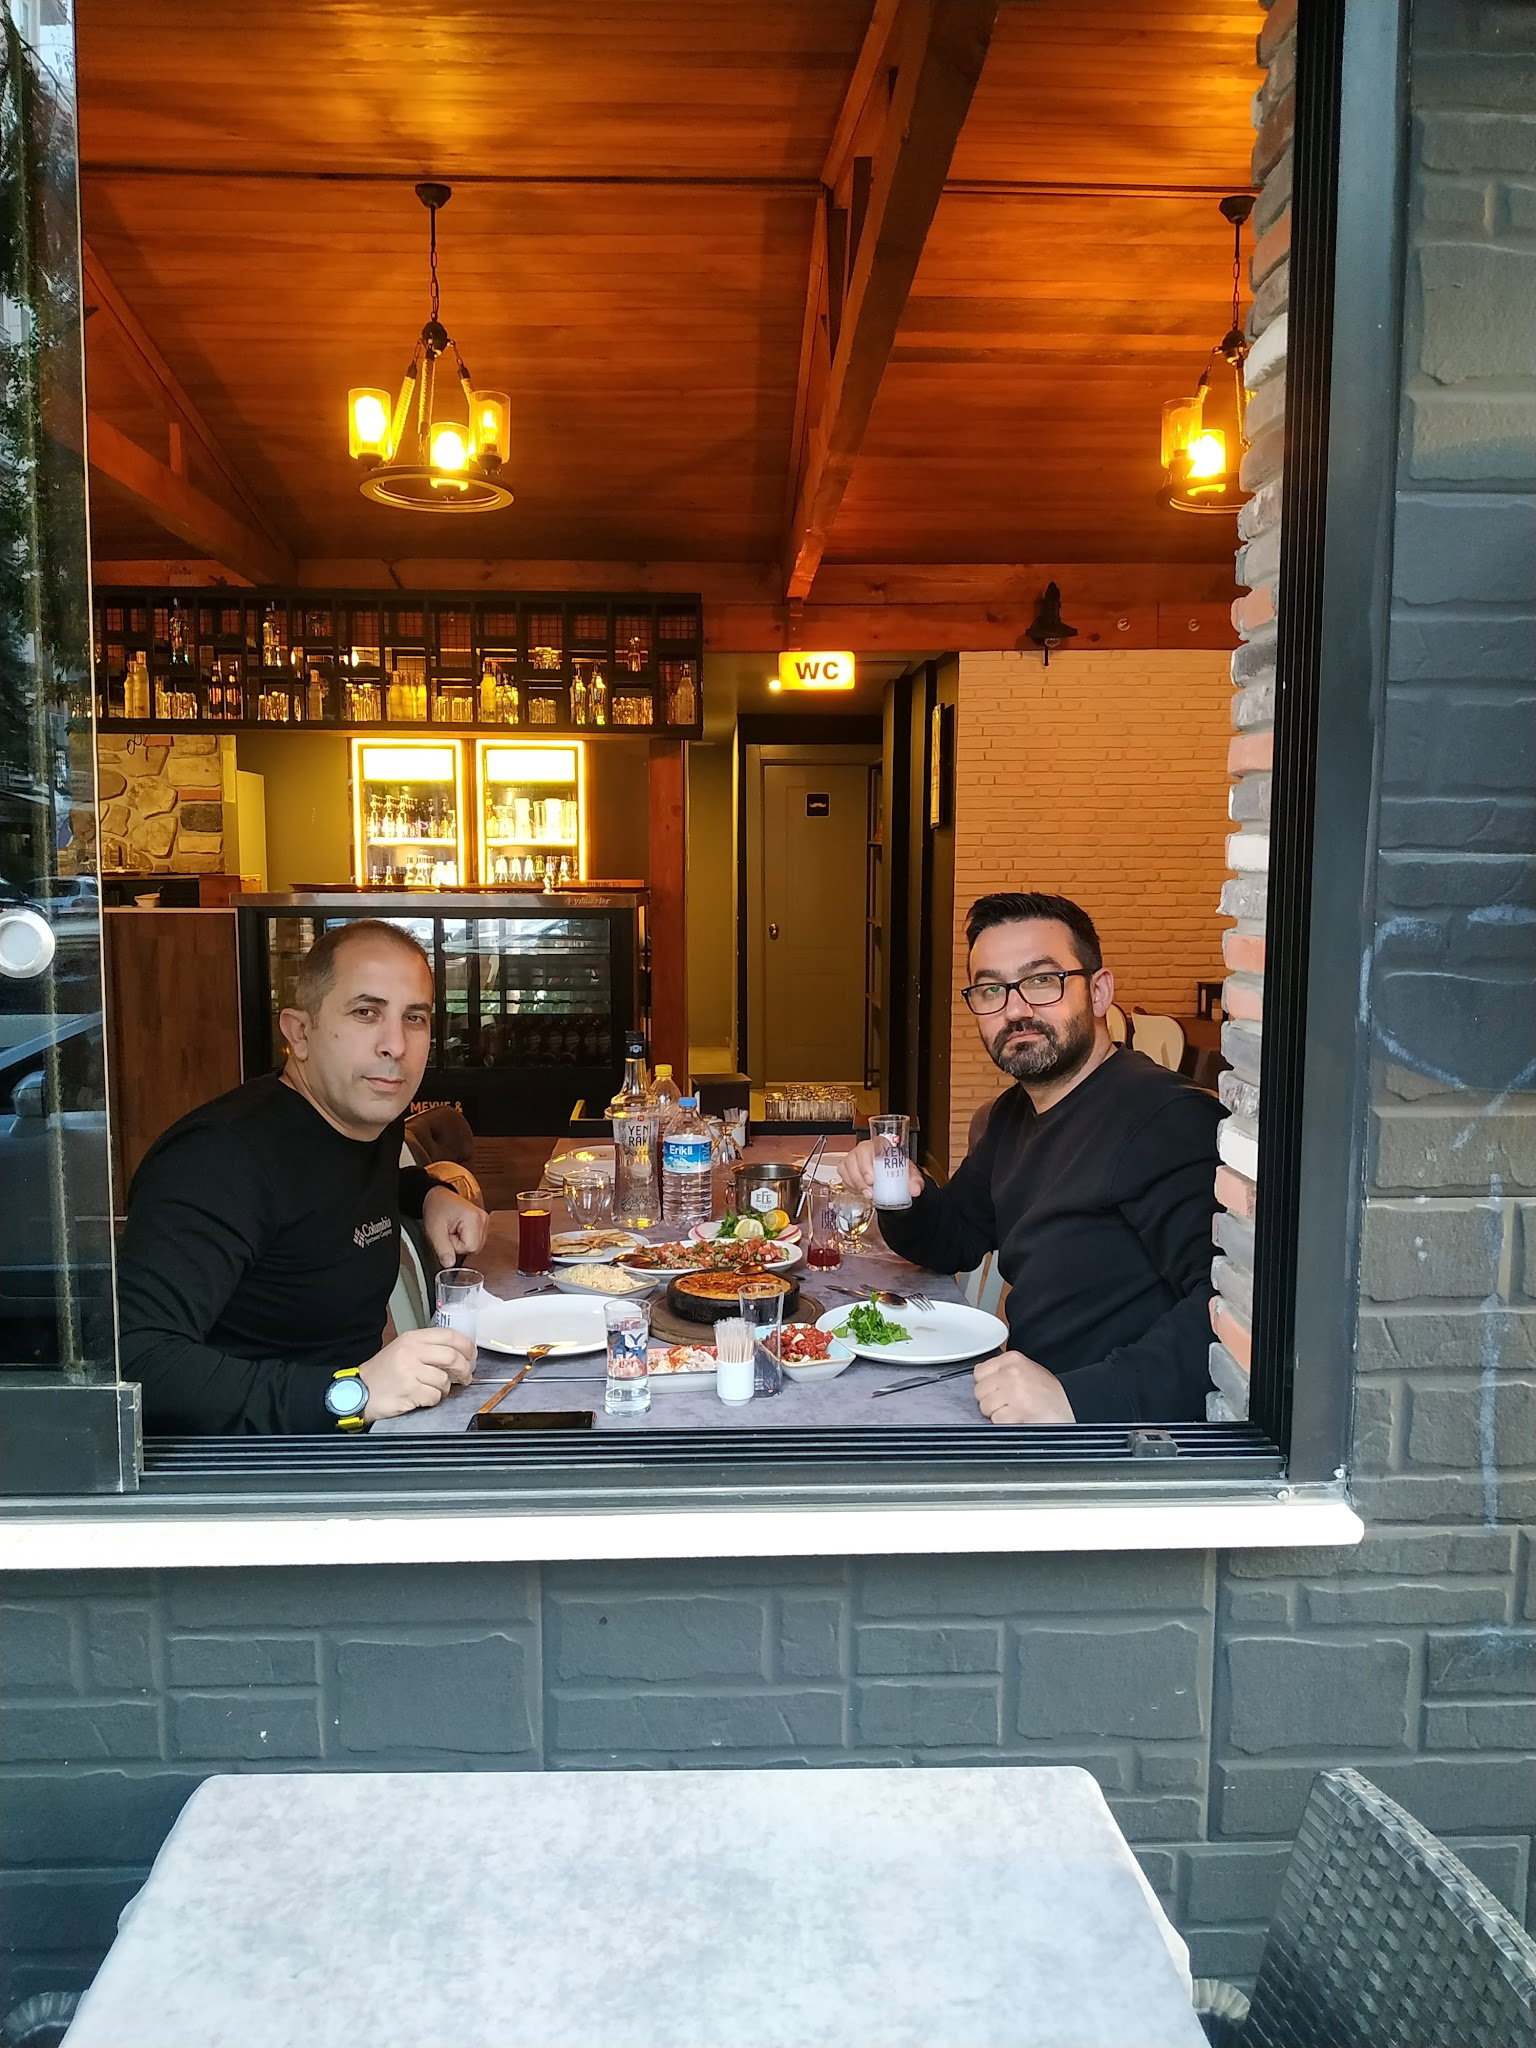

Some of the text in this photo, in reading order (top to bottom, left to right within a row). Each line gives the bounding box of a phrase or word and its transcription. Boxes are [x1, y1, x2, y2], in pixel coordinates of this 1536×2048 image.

[795, 661, 839, 680] WC
[756, 1190, 772, 1204] EFE
[361, 1216, 392, 1238] Columbia
